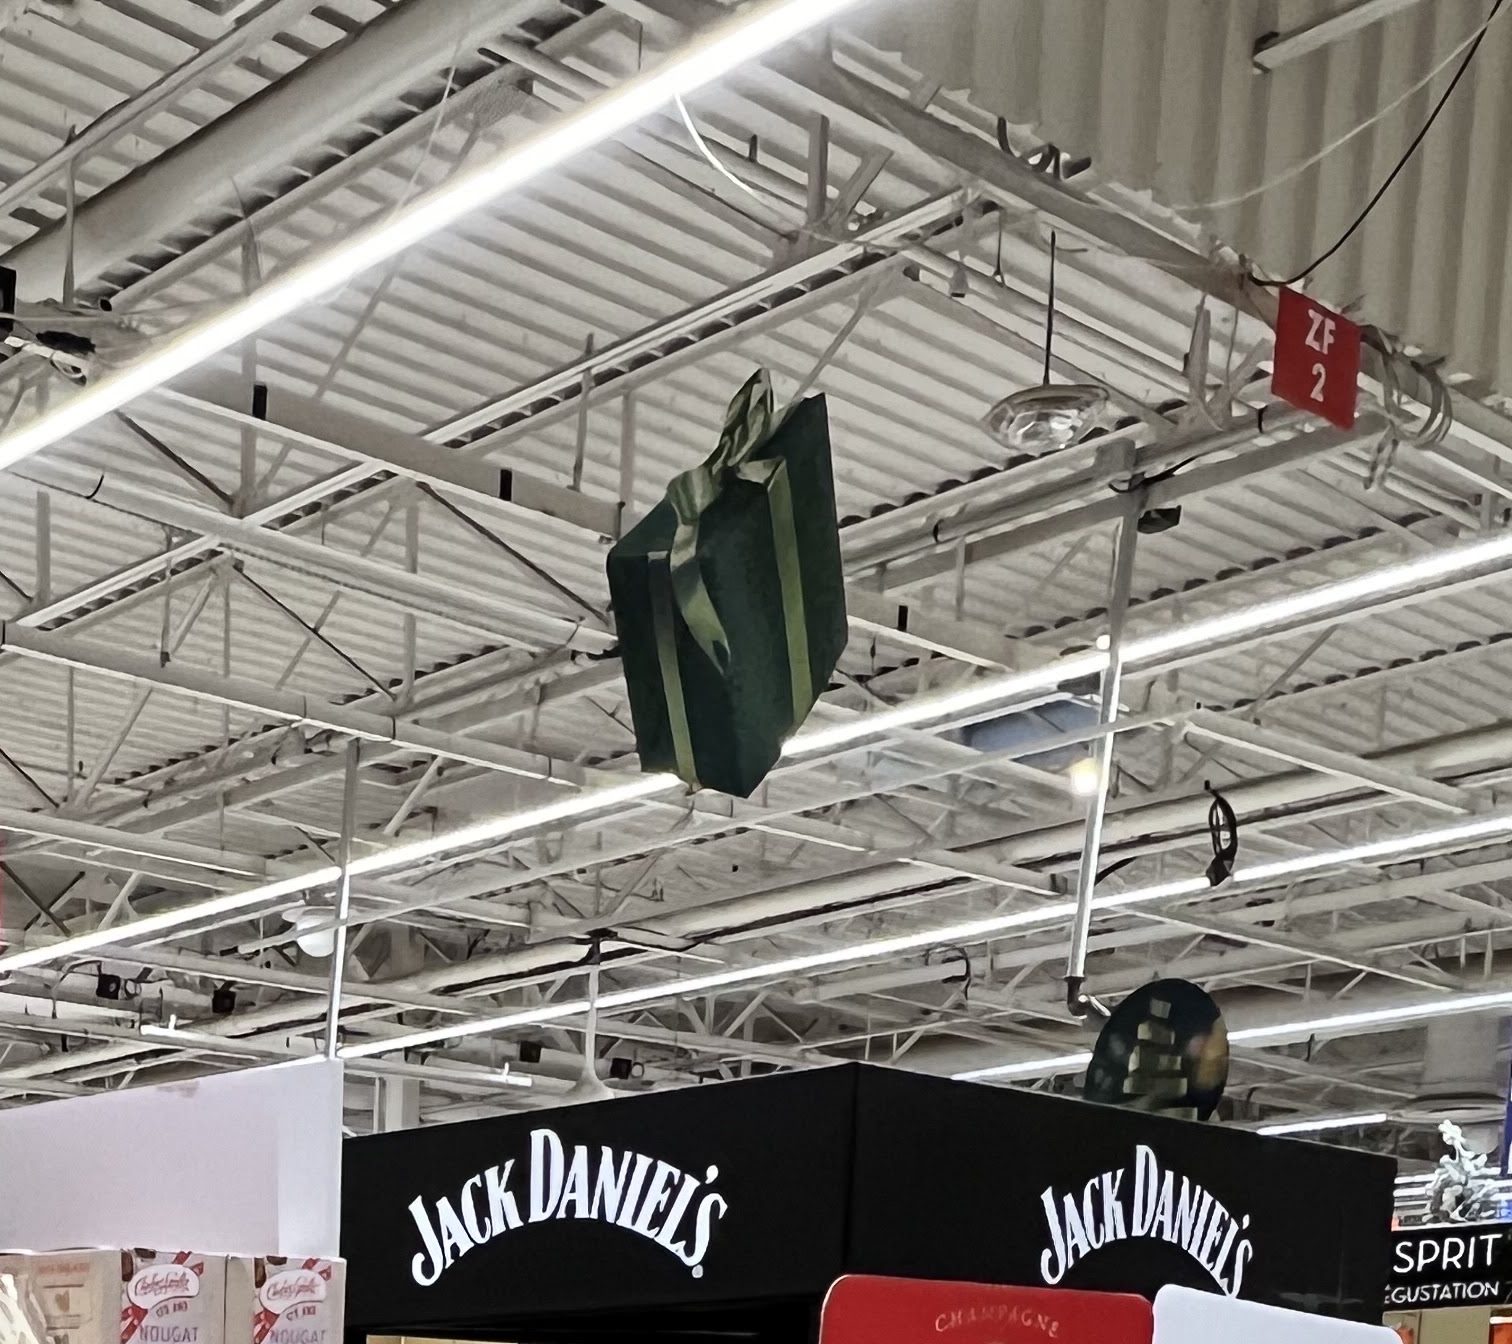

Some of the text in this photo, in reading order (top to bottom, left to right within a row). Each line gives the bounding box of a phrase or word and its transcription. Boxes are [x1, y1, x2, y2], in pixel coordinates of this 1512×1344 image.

[1305, 308, 1336, 355] ZF
[1310, 362, 1326, 403] 2
[408, 1128, 729, 1287] JACK DANIEL'S
[1040, 1144, 1253, 1299] JACK DANIEL'S
[1393, 1233, 1503, 1273] SPRIT
[139, 1325, 199, 1344] NOUGAT
